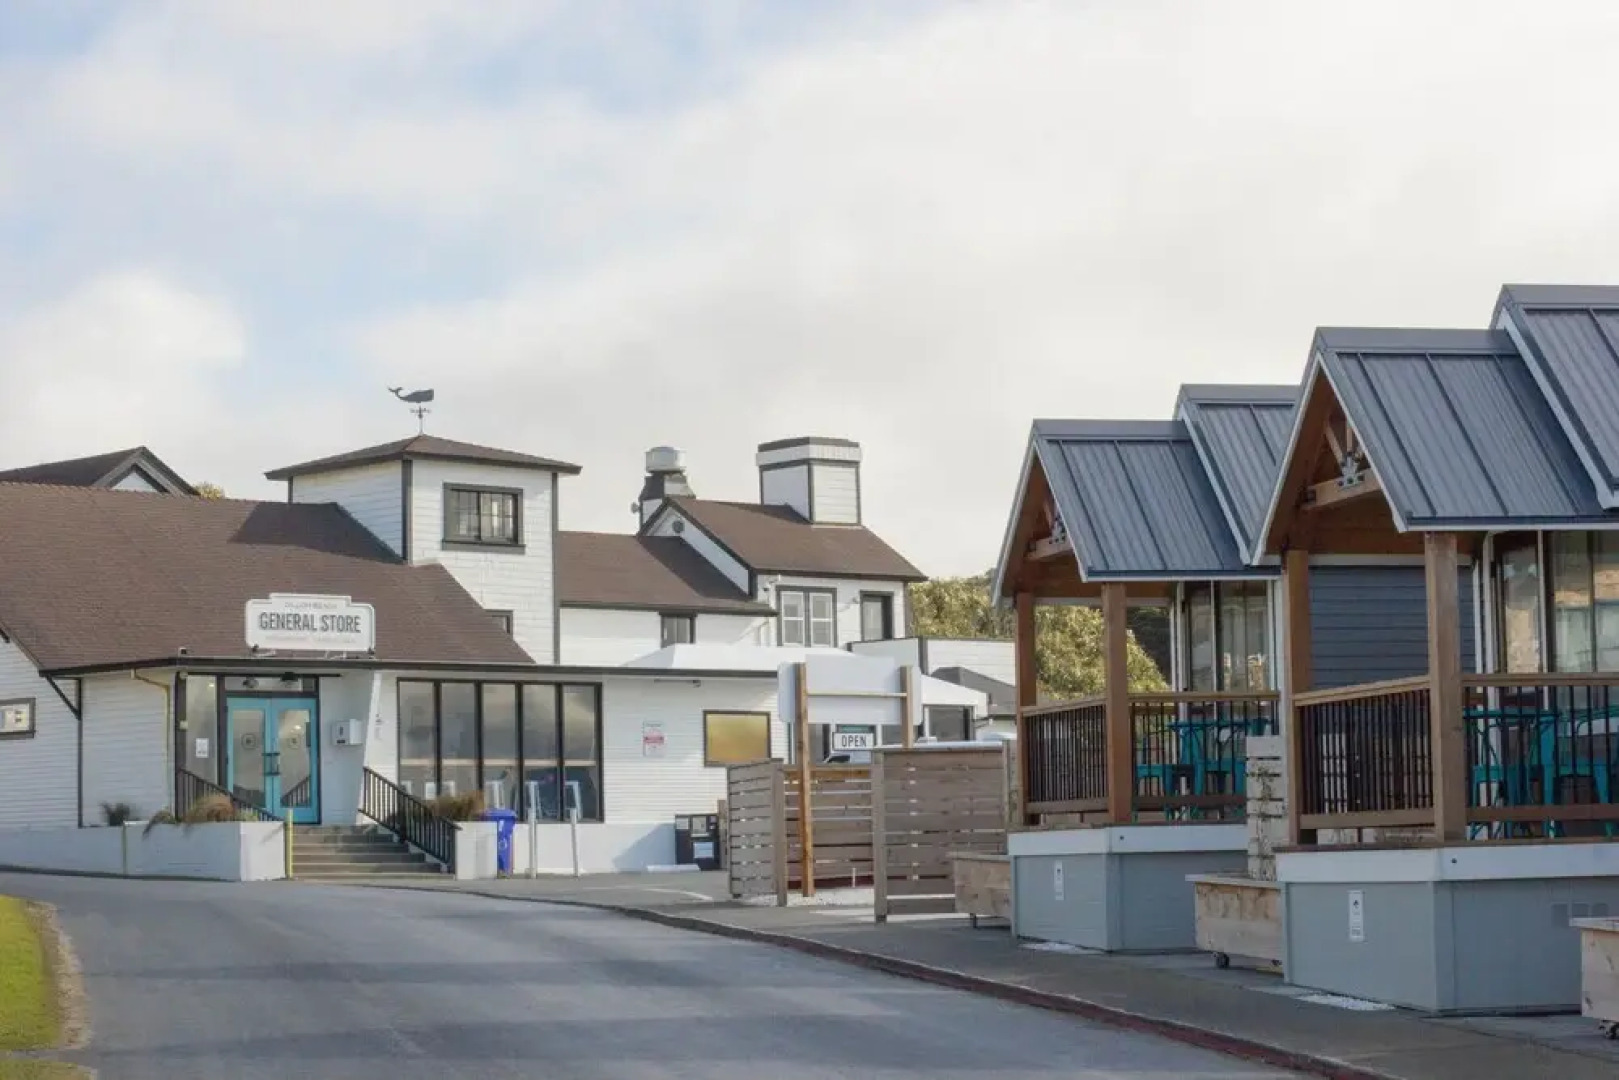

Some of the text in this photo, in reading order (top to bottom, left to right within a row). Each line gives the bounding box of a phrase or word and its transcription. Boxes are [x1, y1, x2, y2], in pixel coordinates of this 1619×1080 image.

[260, 612, 361, 633] GENERAL STORE
[841, 734, 867, 748] OPEN
